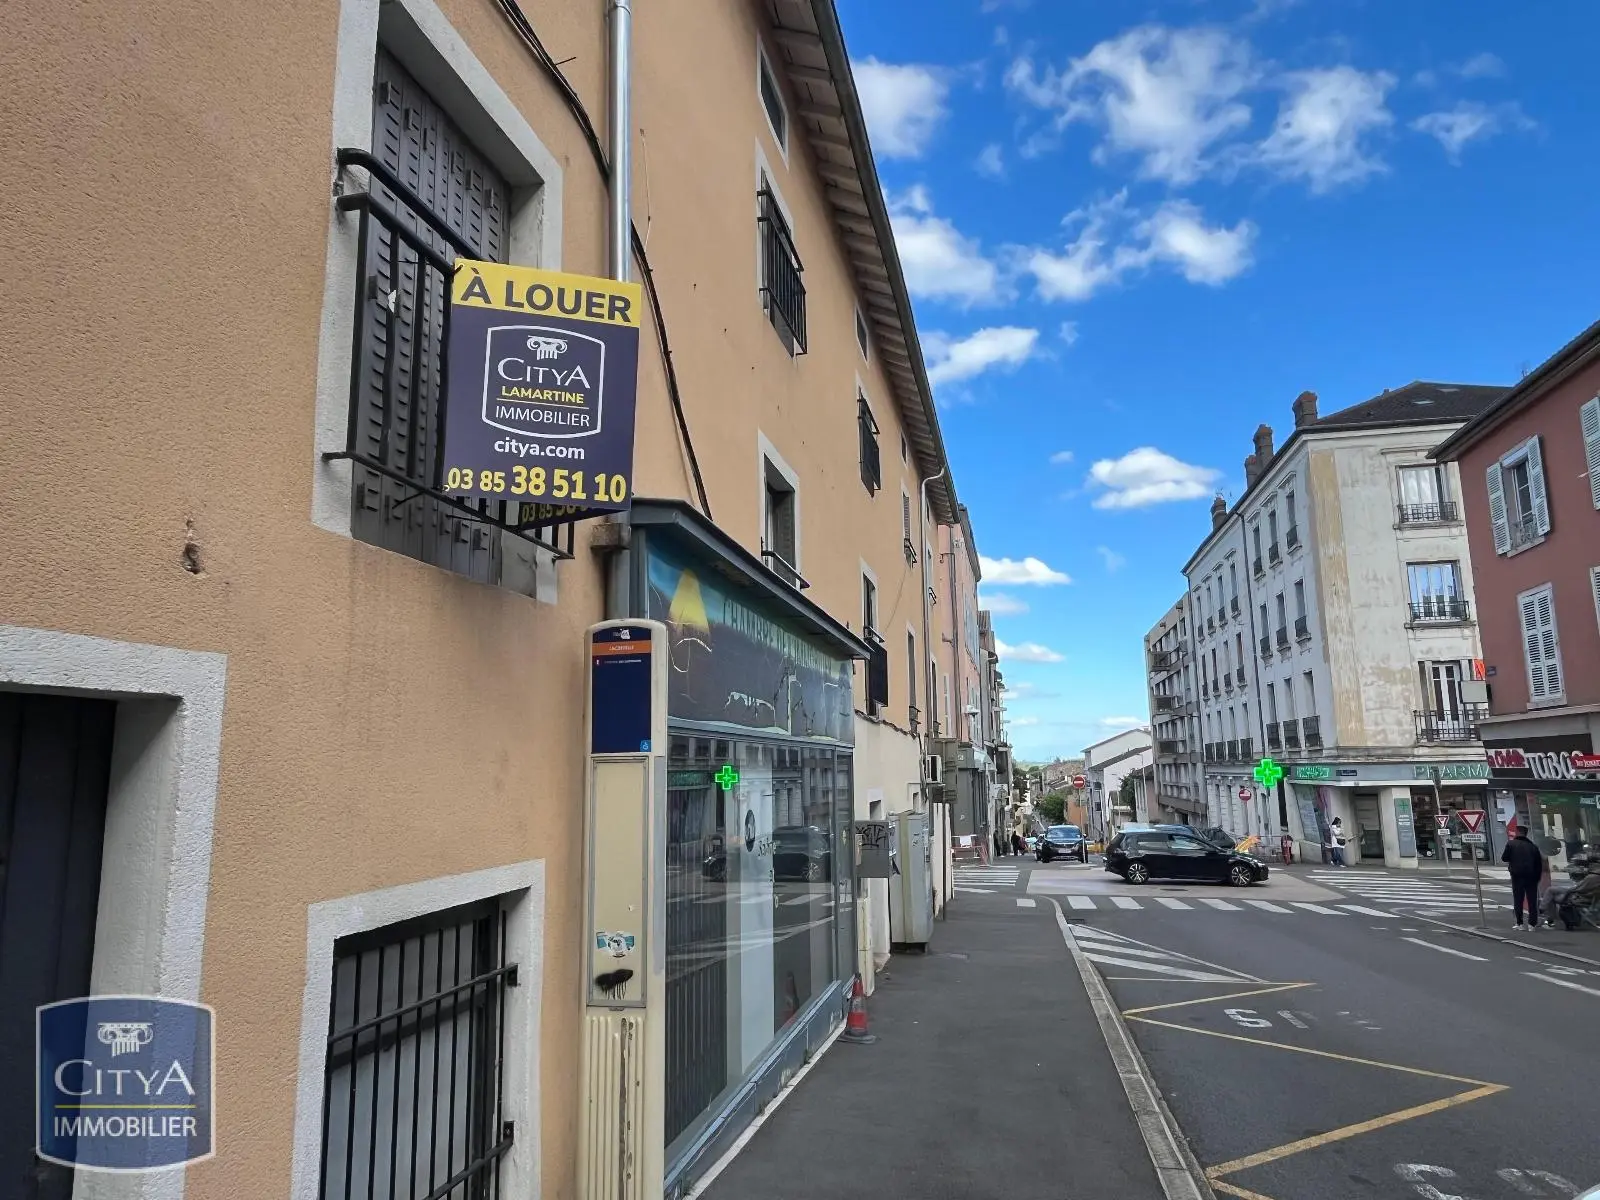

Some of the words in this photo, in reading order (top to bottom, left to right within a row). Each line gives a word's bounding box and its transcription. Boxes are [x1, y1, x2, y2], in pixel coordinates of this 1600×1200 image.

[460, 267, 492, 305] À
[504, 280, 632, 323] LOUER
[497, 357, 591, 389] CITYA
[501, 385, 584, 404] LAMARTINE
[495, 405, 590, 427] IMMOBILIER
[494, 436, 585, 460] citya.com
[447, 467, 474, 490] 03
[479, 470, 505, 493] 85
[511, 465, 546, 496] 38
[552, 468, 587, 500] 51
[593, 473, 627, 503] 10
